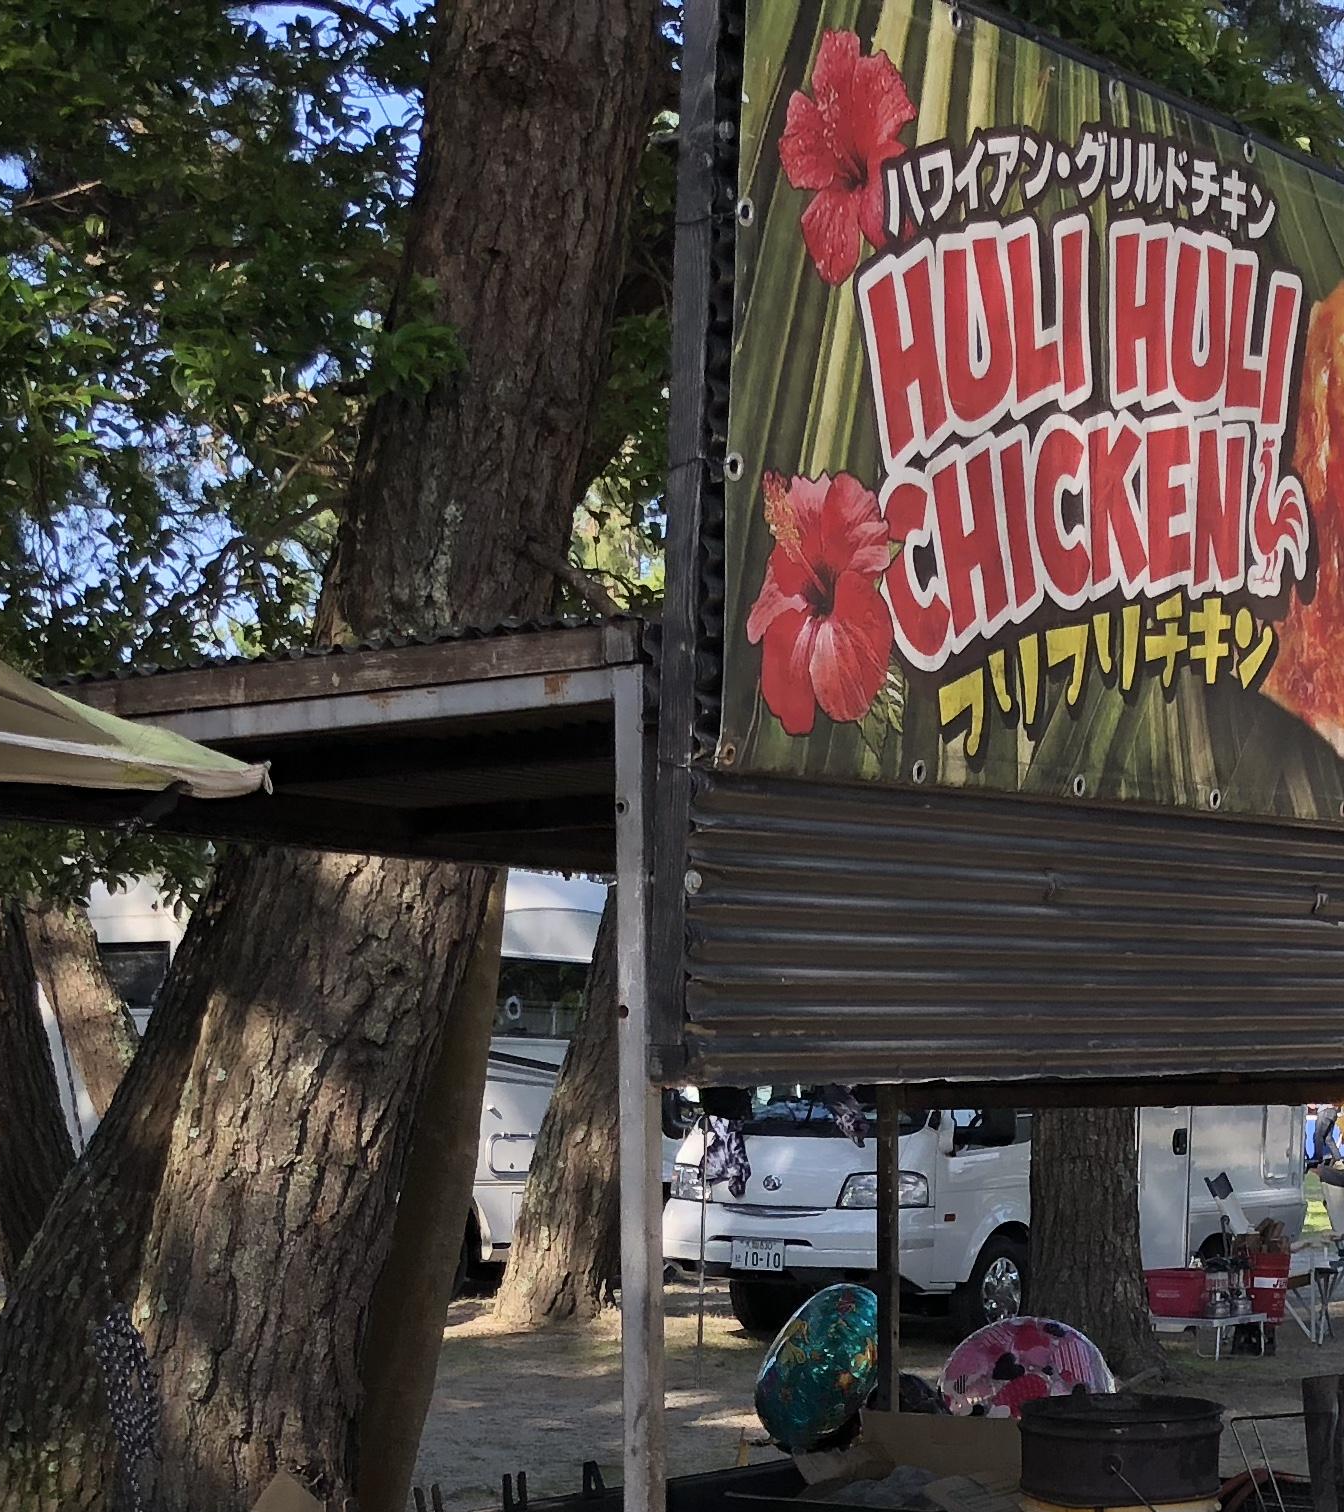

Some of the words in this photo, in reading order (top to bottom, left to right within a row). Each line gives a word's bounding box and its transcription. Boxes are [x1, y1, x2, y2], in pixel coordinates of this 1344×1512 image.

[886, 132, 1275, 239] ハワイアン・グリルドチキン
[859, 214, 1093, 465] HULI
[1109, 218, 1302, 434] HULI
[879, 413, 1253, 671] CHICKEN
[938, 592, 1273, 757] フリフリチキン
